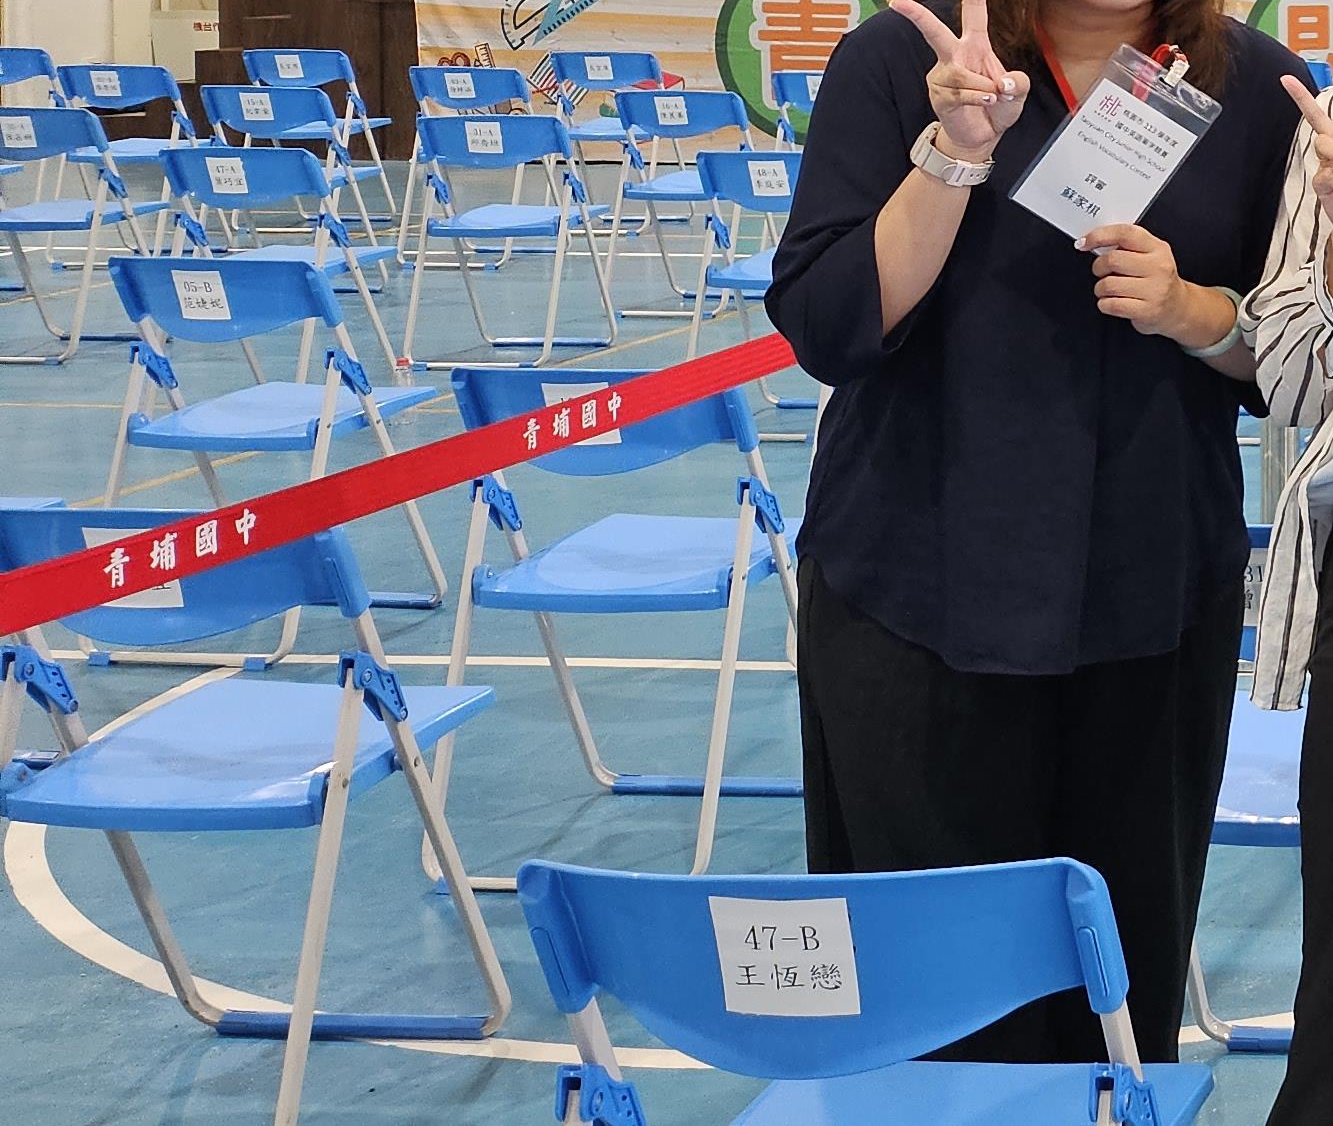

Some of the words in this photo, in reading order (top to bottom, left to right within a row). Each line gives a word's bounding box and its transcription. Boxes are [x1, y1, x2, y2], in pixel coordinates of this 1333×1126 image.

[184, 281, 212, 293] 05-B
[523, 391, 622, 450] 青埔國中
[103, 508, 257, 588] 青埔國中
[744, 924, 821, 951] 47-B
[735, 963, 842, 990] 王恆戀
